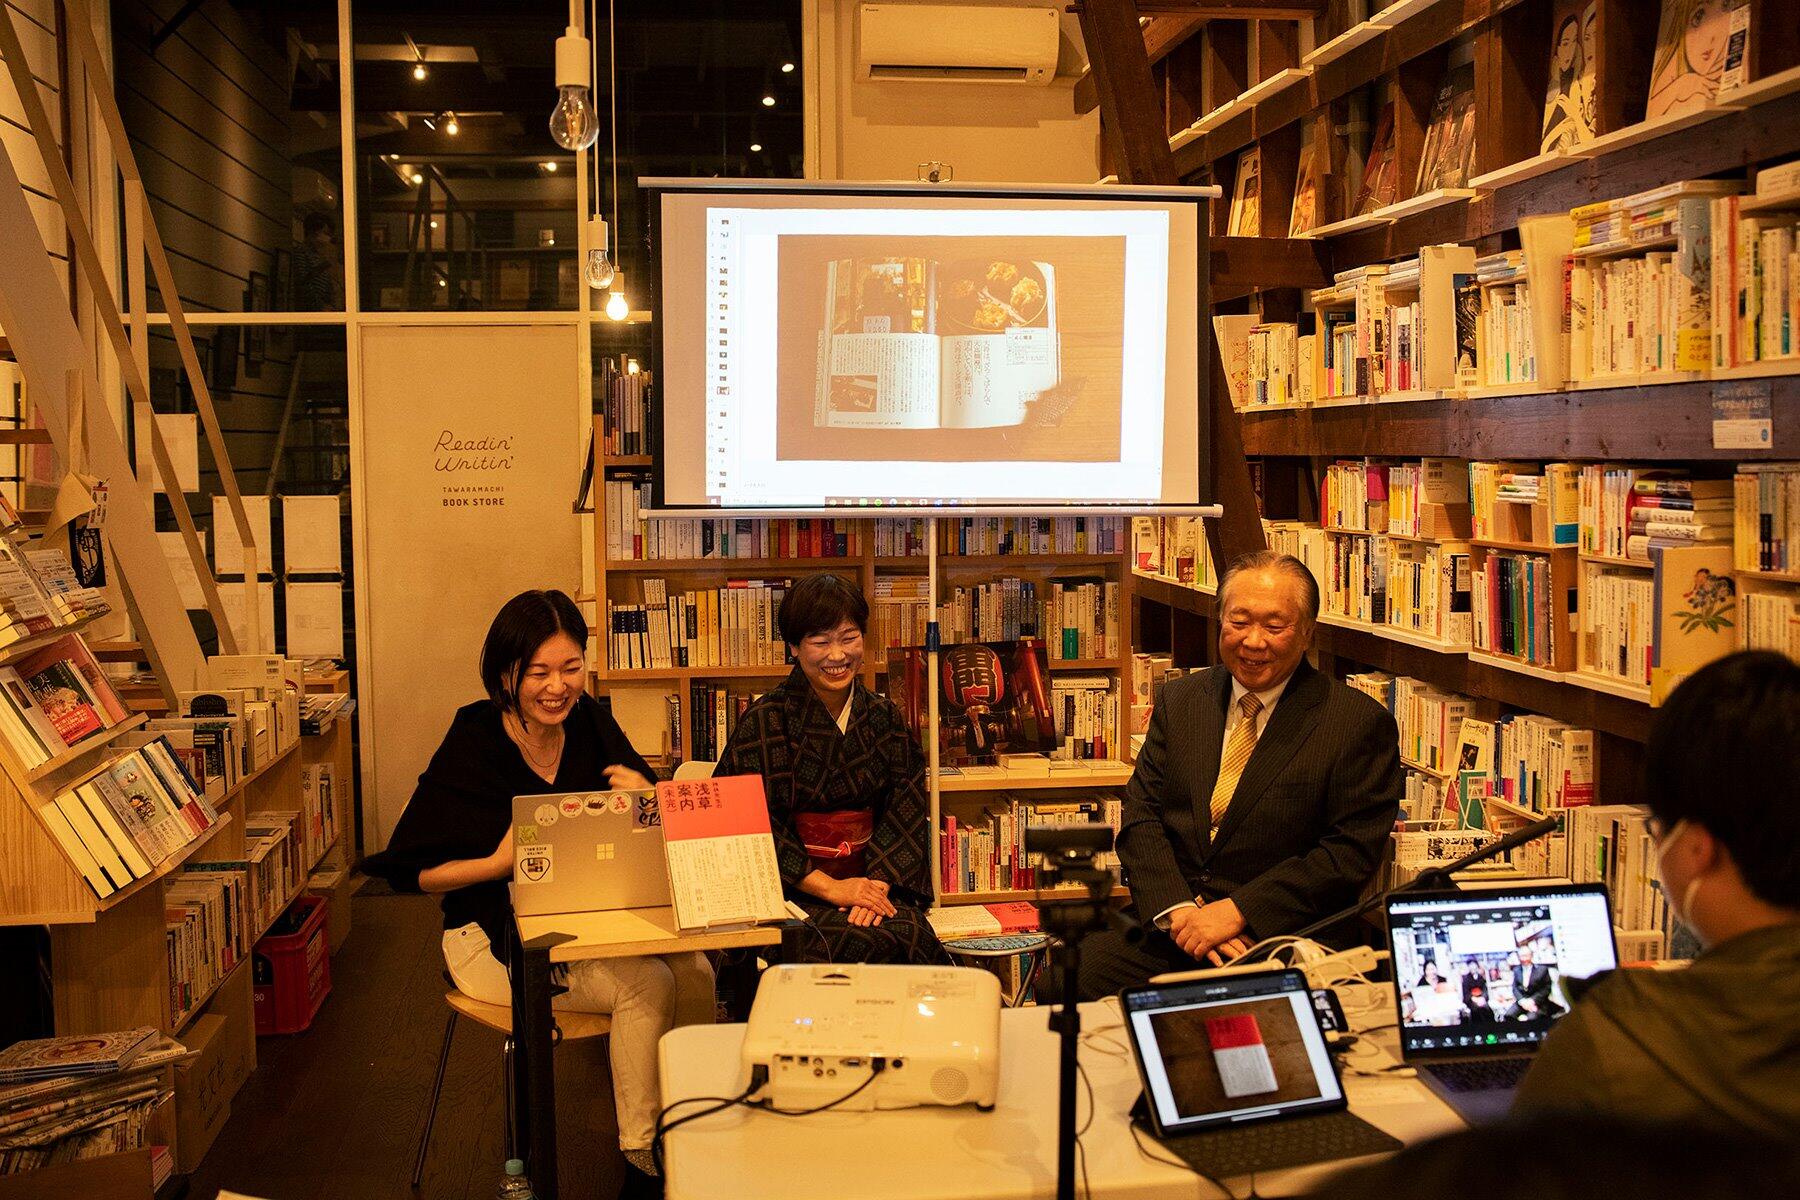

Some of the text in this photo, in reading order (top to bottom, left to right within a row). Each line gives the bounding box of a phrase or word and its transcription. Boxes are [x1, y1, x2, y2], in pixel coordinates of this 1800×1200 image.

[443, 498, 505, 507] BOOK STORE
[677, 784, 695, 812] 案内
[695, 783, 713, 811] 浅草
